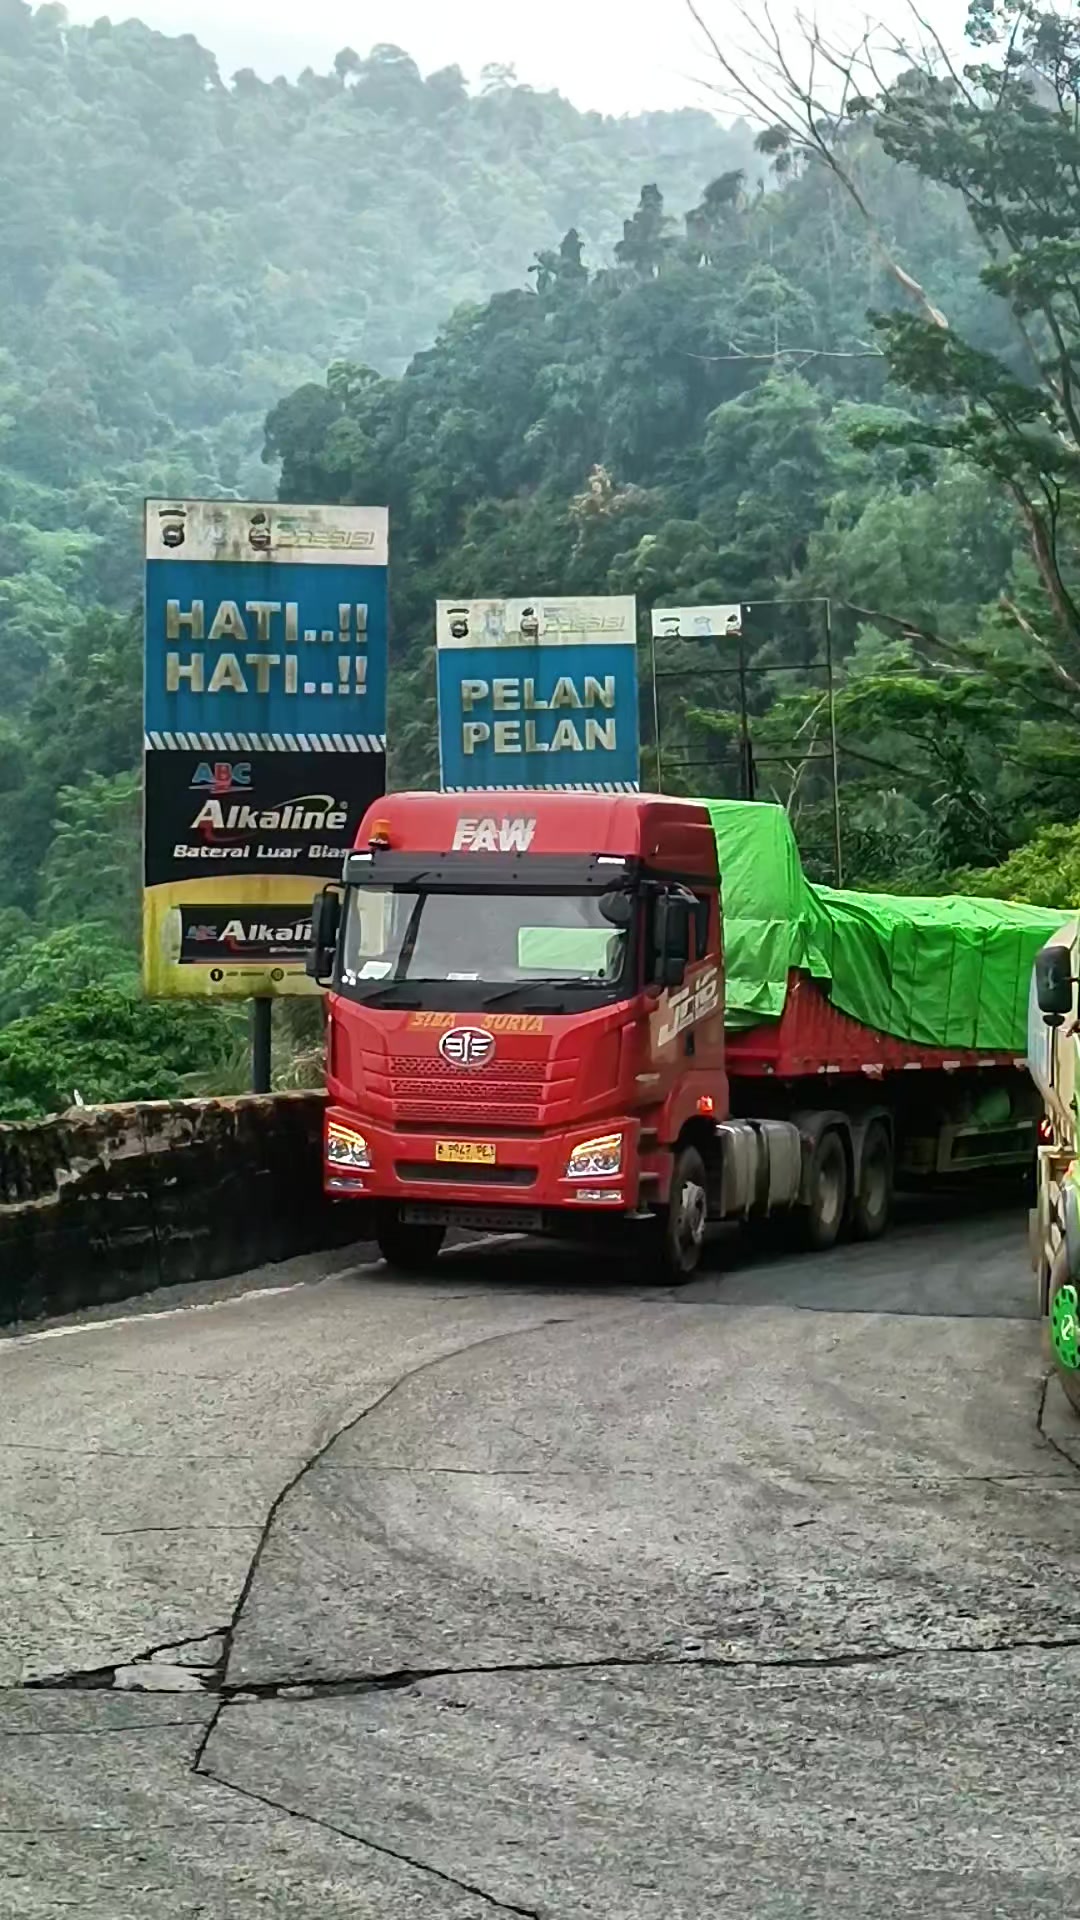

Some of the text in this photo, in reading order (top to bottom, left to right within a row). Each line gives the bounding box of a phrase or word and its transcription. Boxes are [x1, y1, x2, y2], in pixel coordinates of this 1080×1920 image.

[460, 675, 616, 712] PELAN
[462, 718, 617, 755] PELAN
[191, 762, 252, 787] ABC
[190, 799, 348, 830] Alkaline
[451, 818, 537, 852] FAW
[256, 844, 302, 858] Luar
[308, 845, 347, 858] Bias
[217, 919, 313, 941] Alkali
[480, 1014, 544, 1032] SURYA
